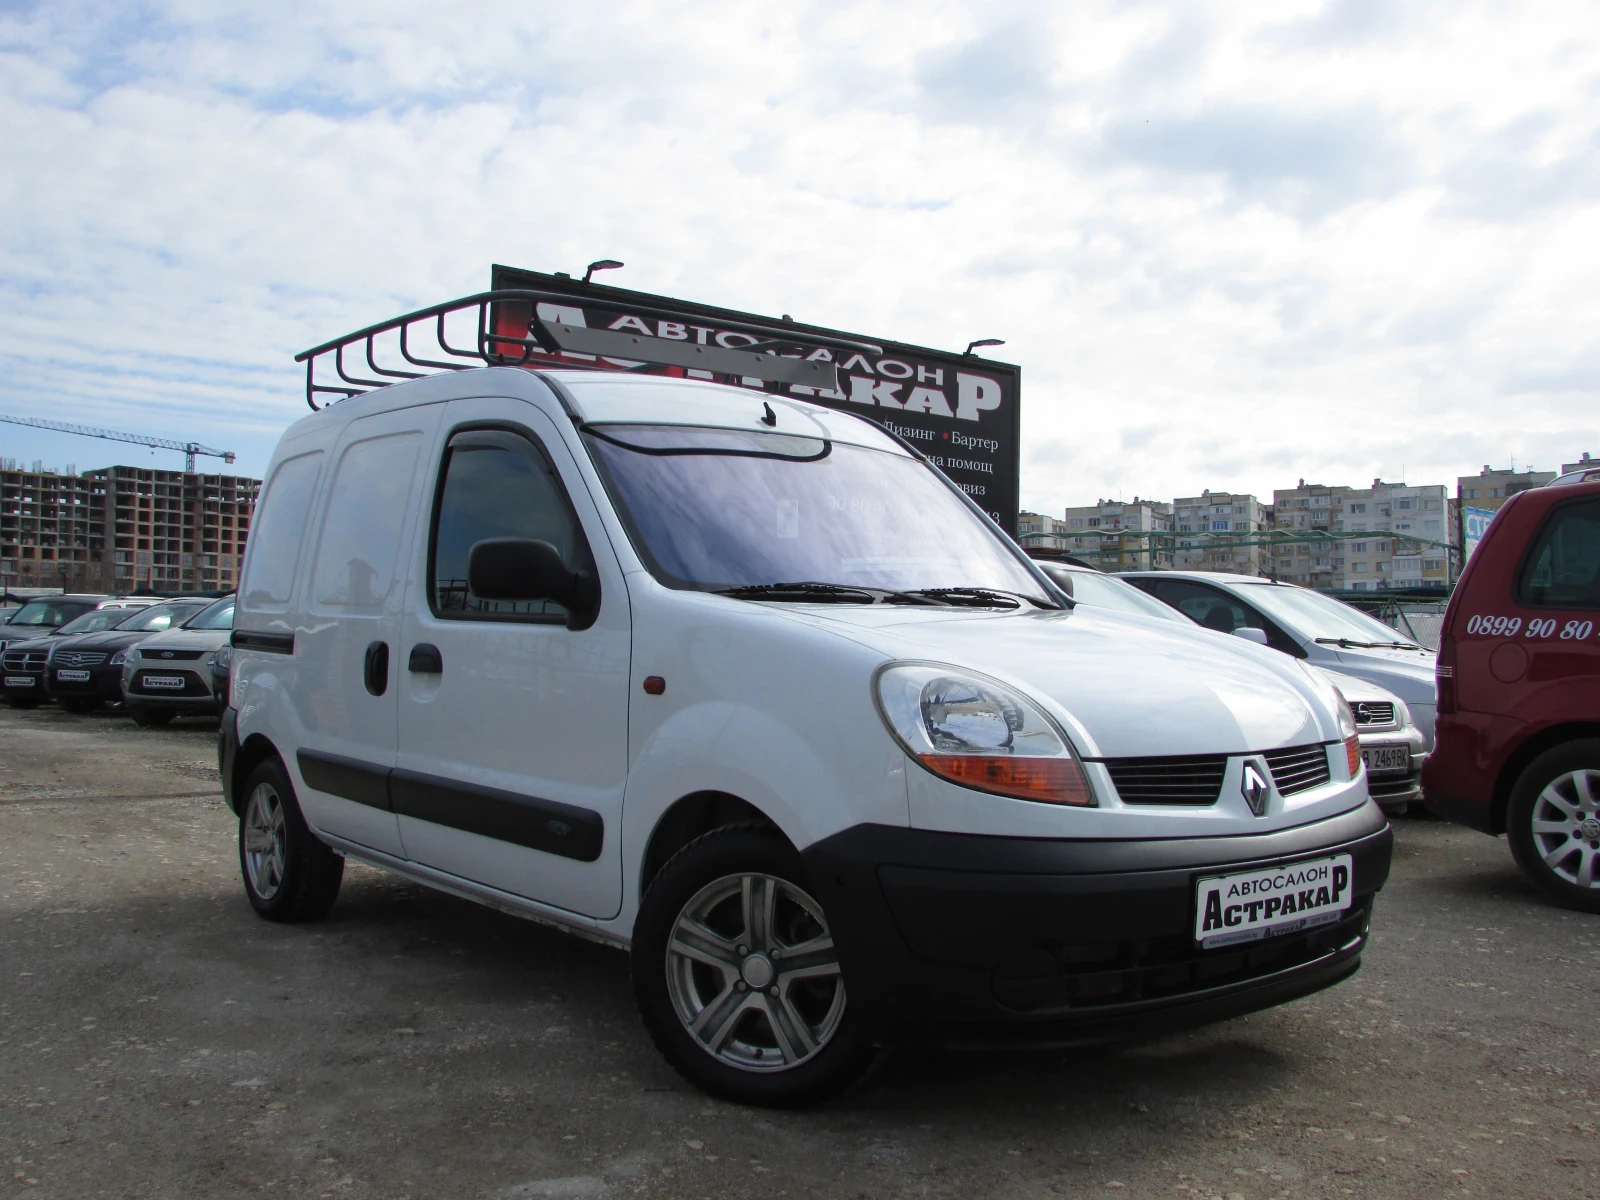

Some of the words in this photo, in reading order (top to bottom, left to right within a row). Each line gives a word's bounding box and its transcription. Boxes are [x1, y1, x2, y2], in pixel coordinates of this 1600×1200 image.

[951, 430, 999, 453] Бартер
[947, 457, 994, 475] помощ
[1466, 614, 1522, 637] 0899
[1524, 618, 1557, 639] 90
[1559, 620, 1593, 640] 80
[1227, 866, 1328, 898] АВТОСАЛОН
[1202, 865, 1348, 932] АСТРАКАР
